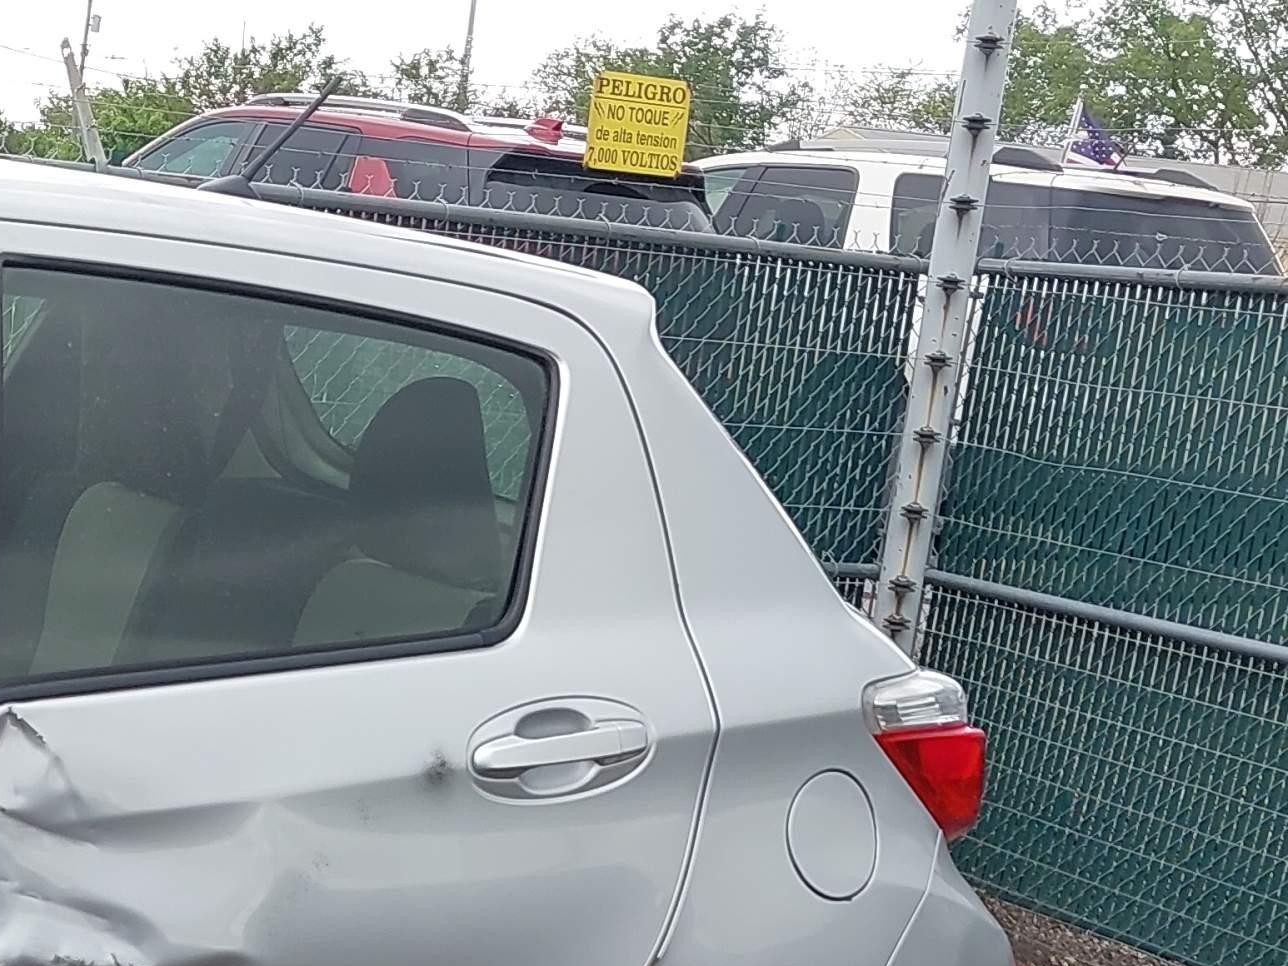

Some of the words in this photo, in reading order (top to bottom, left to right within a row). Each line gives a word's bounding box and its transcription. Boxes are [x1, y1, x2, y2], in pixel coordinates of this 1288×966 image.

[596, 77, 687, 105] PELIGRO
[607, 103, 625, 121] NO
[629, 106, 670, 127] TOQUE
[595, 125, 610, 141] de
[612, 128, 633, 144] alta
[636, 130, 677, 149] tension
[588, 146, 618, 165] 7,000
[621, 150, 678, 171] VOLTIOS
